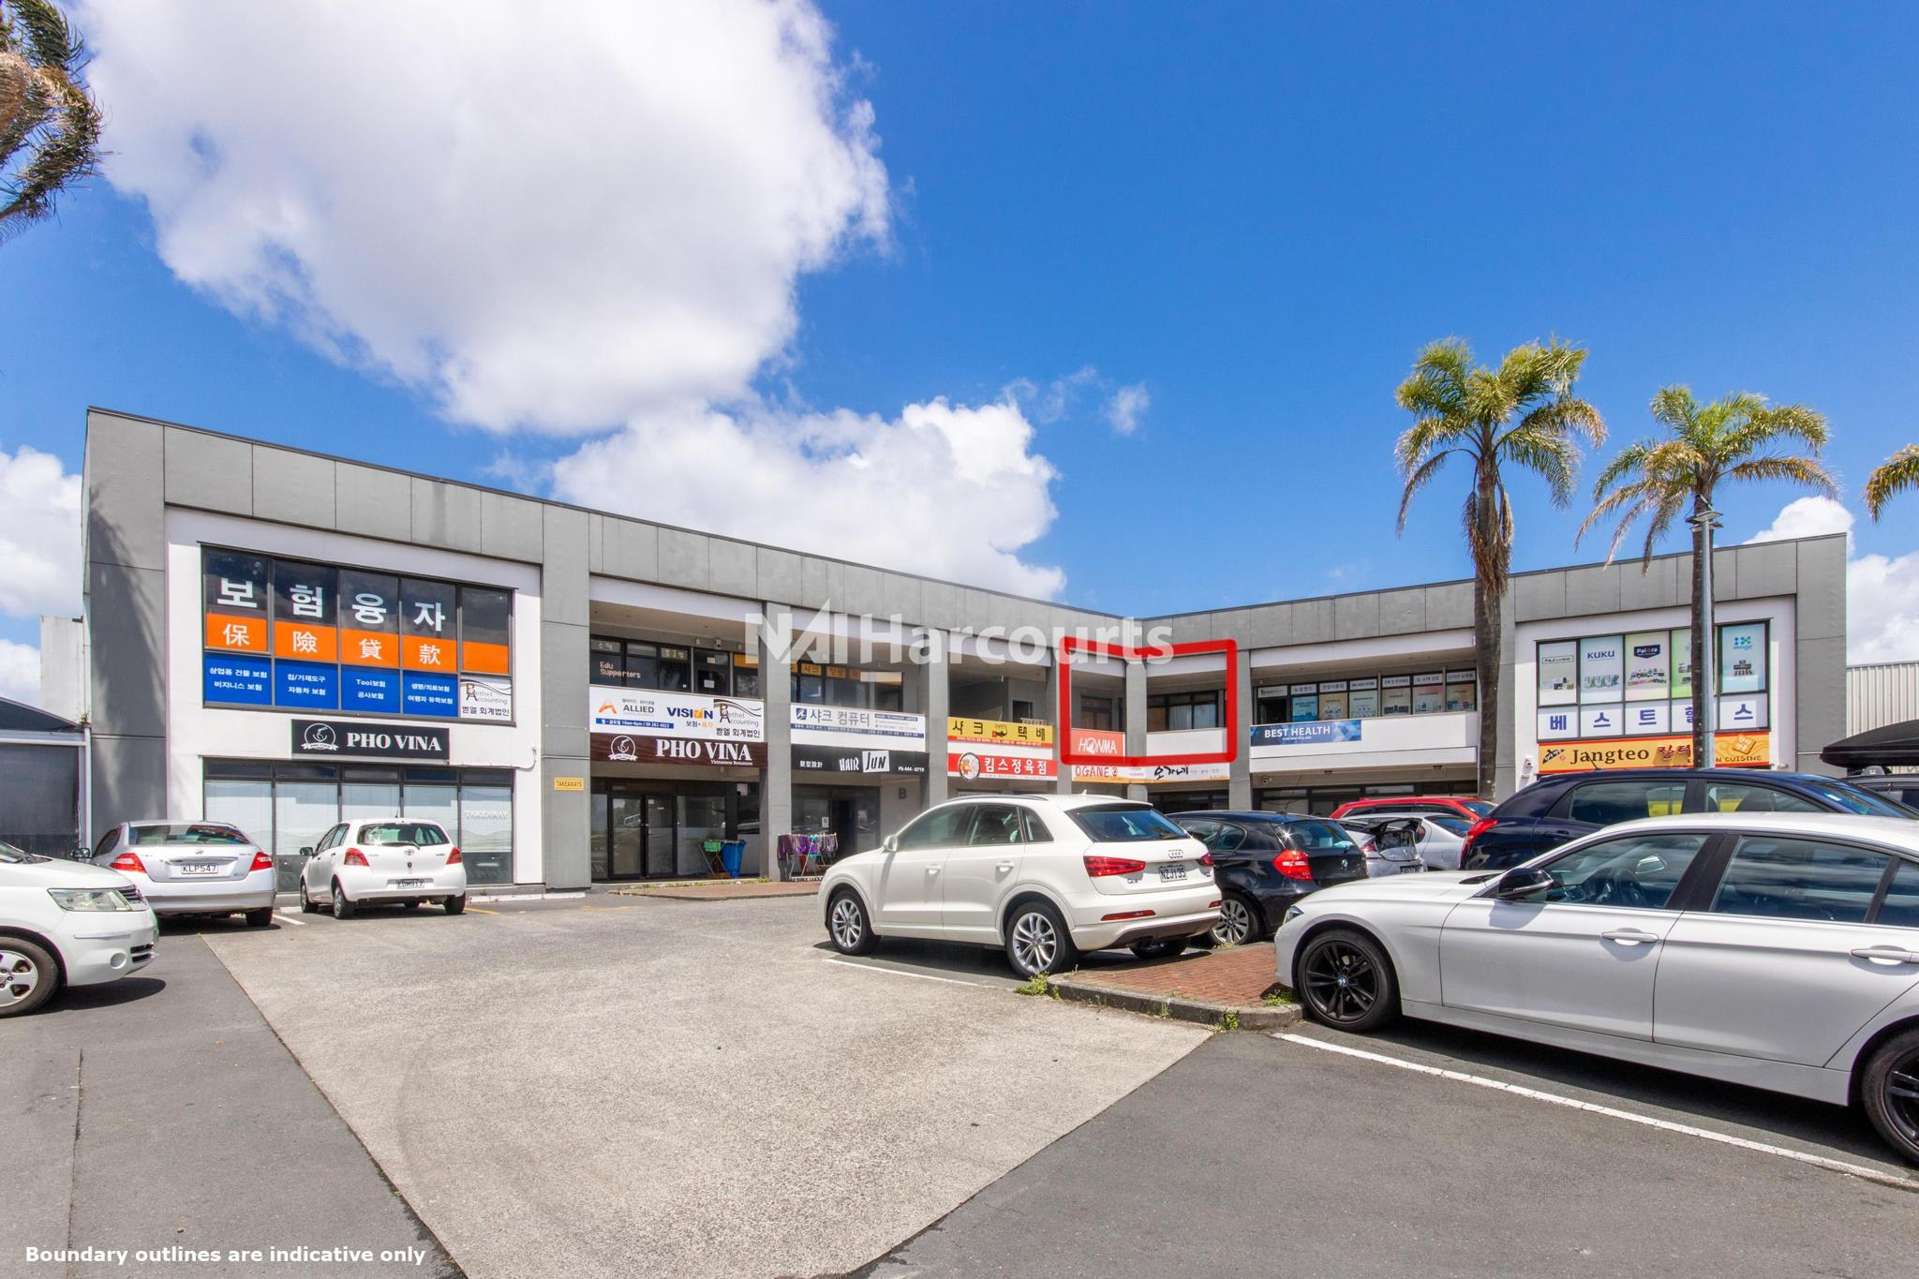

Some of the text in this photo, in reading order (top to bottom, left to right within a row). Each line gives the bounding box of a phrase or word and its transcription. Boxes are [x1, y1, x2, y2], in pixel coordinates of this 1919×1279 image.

[623, 704, 655, 714] ALLIED
[837, 711, 870, 728] 컴퓨터
[1264, 725, 1331, 738] BEST HEALTH
[346, 732, 442, 752] PHO VINA
[656, 738, 753, 761] PHO VINA
[839, 752, 886, 771] HAIR JUN
[1570, 748, 1649, 764] Jangteo
